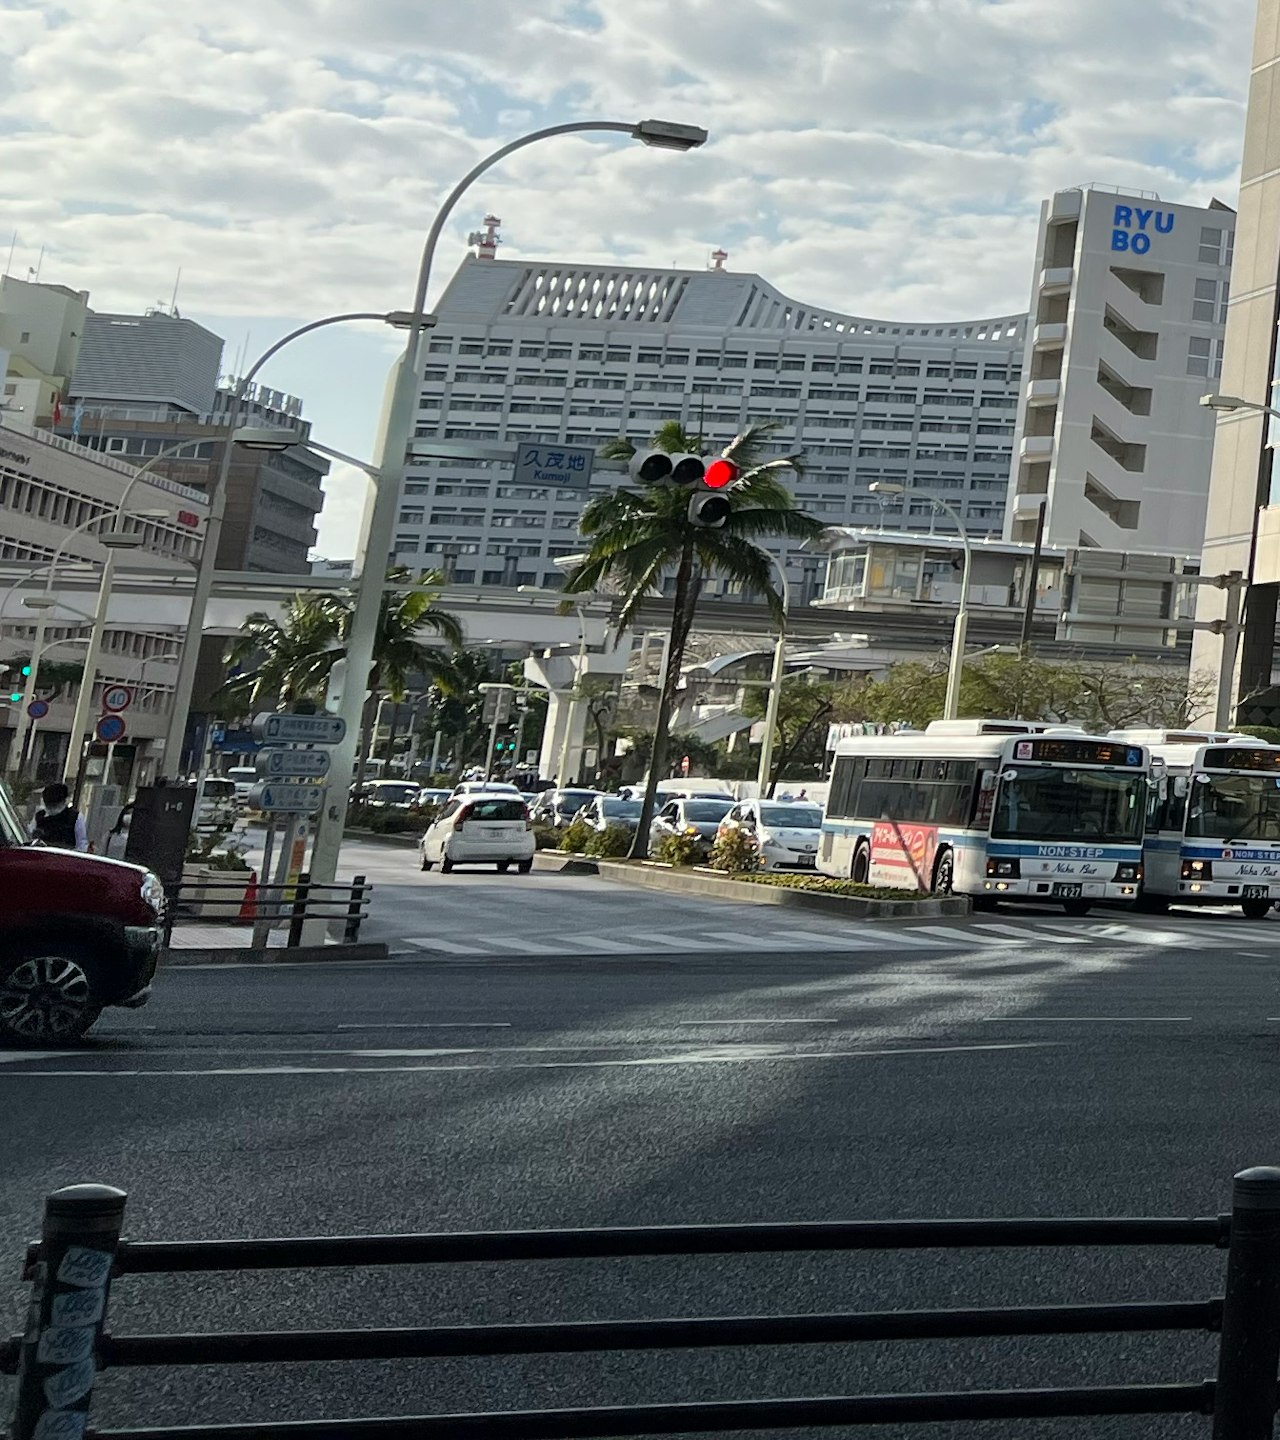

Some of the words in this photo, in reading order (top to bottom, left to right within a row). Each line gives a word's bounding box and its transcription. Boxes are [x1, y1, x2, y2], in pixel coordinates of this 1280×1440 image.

[1113, 205, 1174, 235] RYU
[1110, 229, 1151, 255] BO
[523, 450, 585, 471] 久茂地
[534, 470, 571, 484] Kumoji
[109, 693, 125, 705] 40
